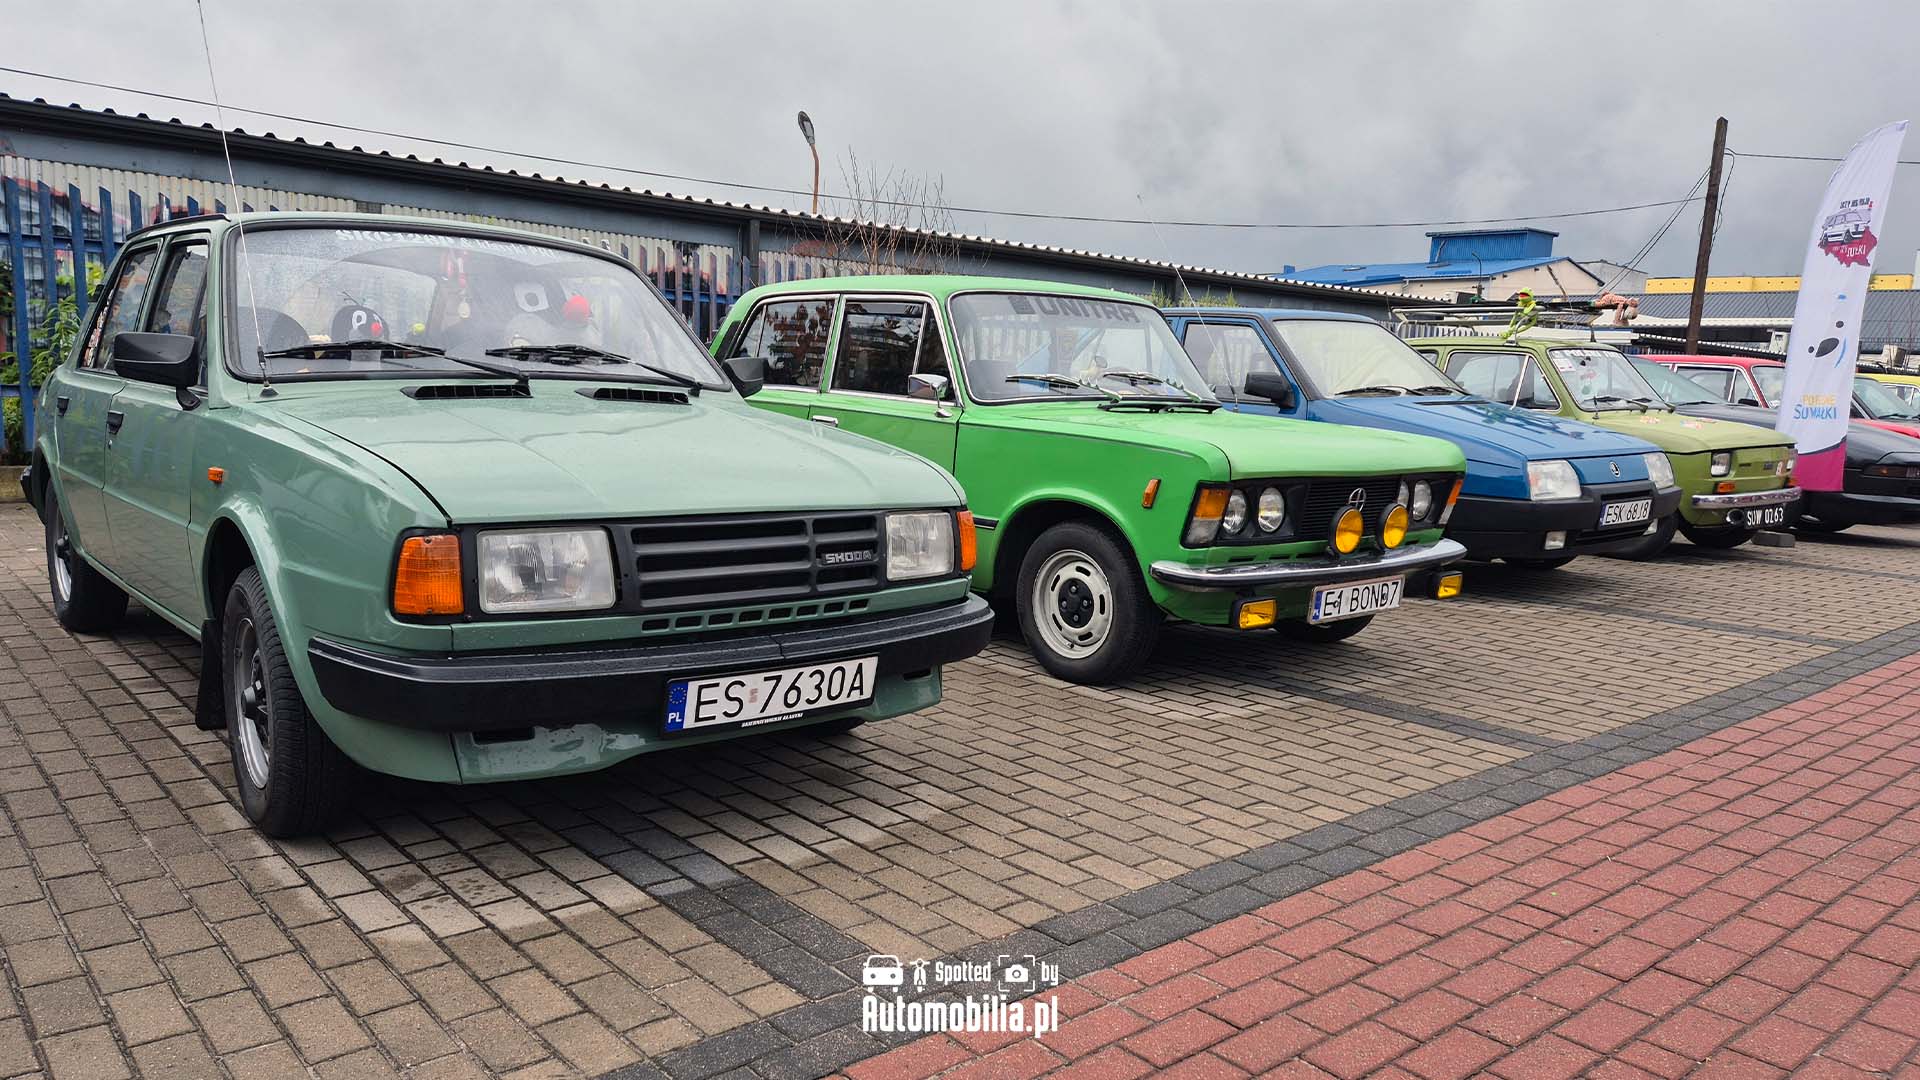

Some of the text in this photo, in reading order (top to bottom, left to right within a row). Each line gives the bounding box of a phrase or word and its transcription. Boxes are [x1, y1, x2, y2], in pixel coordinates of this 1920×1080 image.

[1034, 297, 1140, 323] UNITRA
[1605, 504, 1626, 524] ESK
[1747, 507, 1784, 526] SUW 0263
[825, 550, 872, 564] SKODA
[1323, 581, 1400, 616] E1 BOND7
[694, 662, 865, 723] ES 7630A
[667, 711, 683, 724] PL
